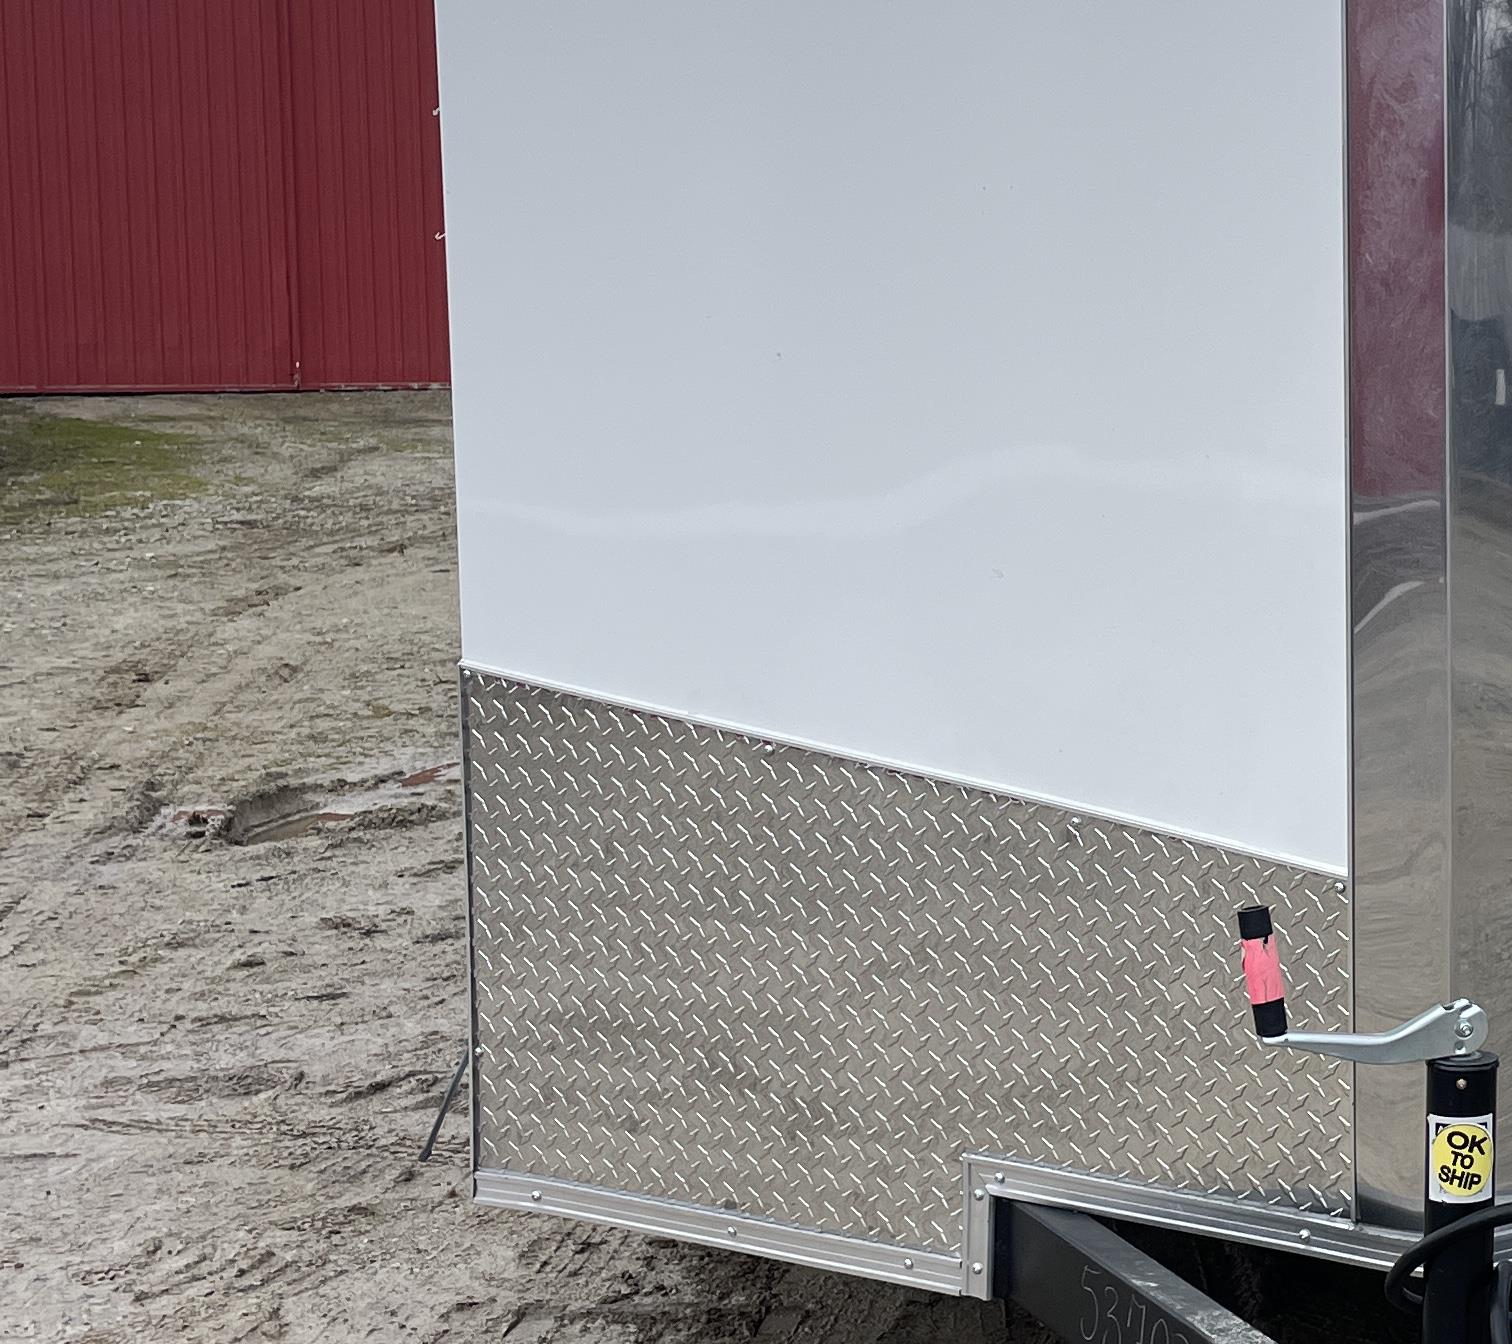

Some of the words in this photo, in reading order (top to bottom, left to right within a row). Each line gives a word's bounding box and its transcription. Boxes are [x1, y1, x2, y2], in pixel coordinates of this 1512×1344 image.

[1447, 1130, 1487, 1155] OK
[1451, 1150, 1475, 1169] TO
[1438, 1164, 1482, 1191] SHIP
